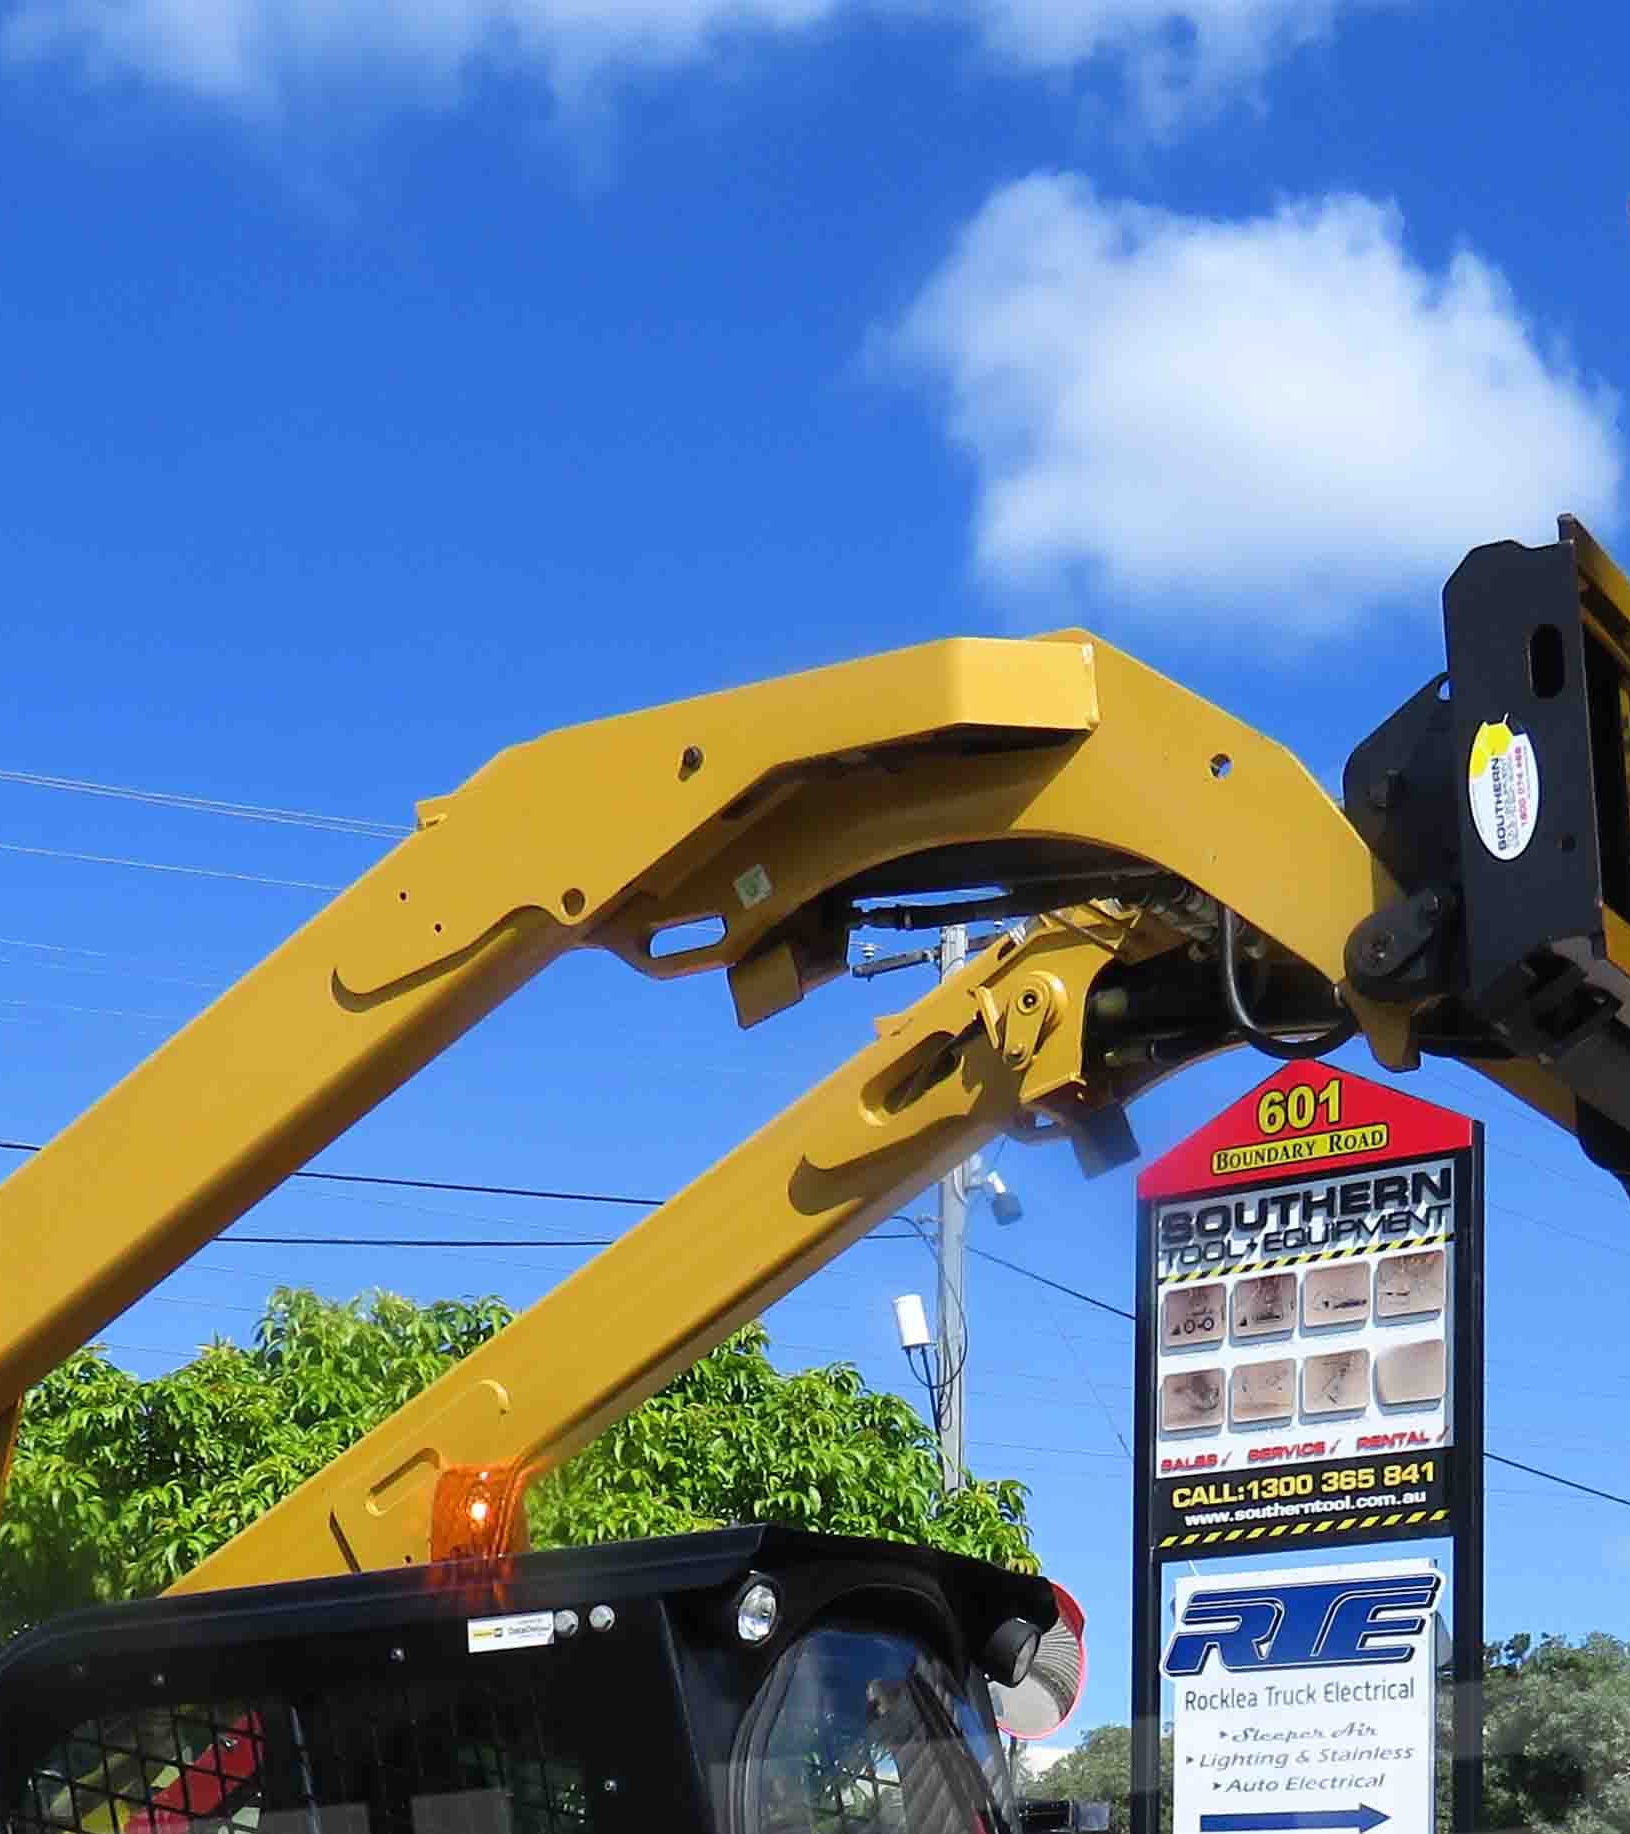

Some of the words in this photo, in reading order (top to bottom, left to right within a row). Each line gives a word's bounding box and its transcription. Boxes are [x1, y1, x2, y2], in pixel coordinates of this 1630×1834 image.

[1491, 758, 1507, 851] SOUTHERN
[1258, 1078, 1342, 1135] 601
[1216, 1141, 1316, 1172] BOUNDARY
[1329, 1130, 1384, 1153] ROAD
[1160, 1167, 1452, 1243] SOUTHERN
[1161, 1453, 1218, 1472] SALES
[1247, 1441, 1327, 1462] SERVICE
[1356, 1431, 1429, 1451] RENTAL
[1172, 1474, 1313, 1508] CALL:1300
[1321, 1467, 1375, 1493] 365
[1383, 1461, 1436, 1487] 841
[1184, 1490, 1427, 1527] www.southerntool.com.au
[1163, 1573, 1441, 1676] RTE
[1185, 1688, 1258, 1711] Rocklea
[1266, 1683, 1317, 1707] Truck
[1323, 1677, 1415, 1704] Electrical
[1231, 1726, 1326, 1744] Sleeper
[1331, 1721, 1379, 1739] Air
[1199, 1750, 1289, 1771] Lighting
[1295, 1749, 1311, 1764] &
[1318, 1745, 1416, 1764] Stainless
[1225, 1778, 1279, 1794] Auto
[1285, 1773, 1386, 1792] Electrical
